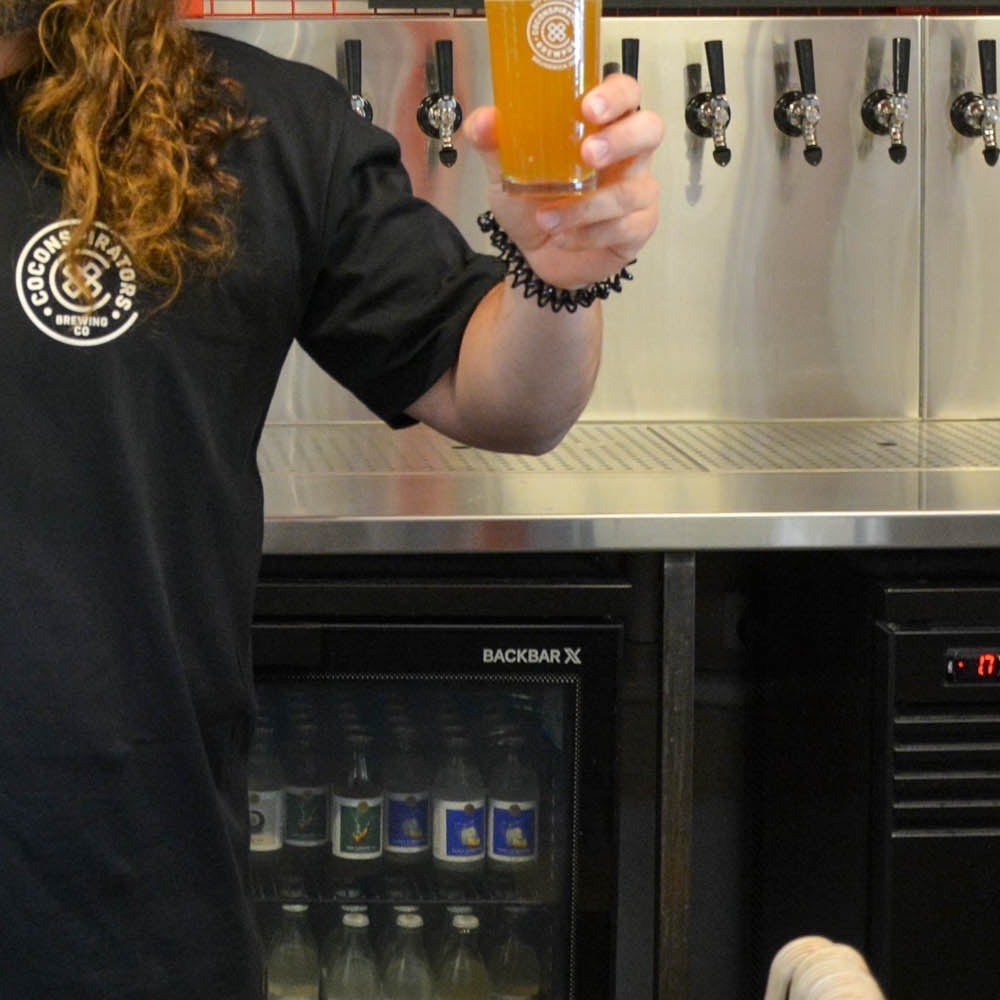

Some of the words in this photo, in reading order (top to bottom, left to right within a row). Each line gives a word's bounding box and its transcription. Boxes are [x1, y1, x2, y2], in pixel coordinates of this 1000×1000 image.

[26, 229, 137, 311] COCONSIRATORS
[55, 314, 108, 328] BREWING
[73, 326, 90, 336] CO
[483, 648, 561, 664] BACKBAR
